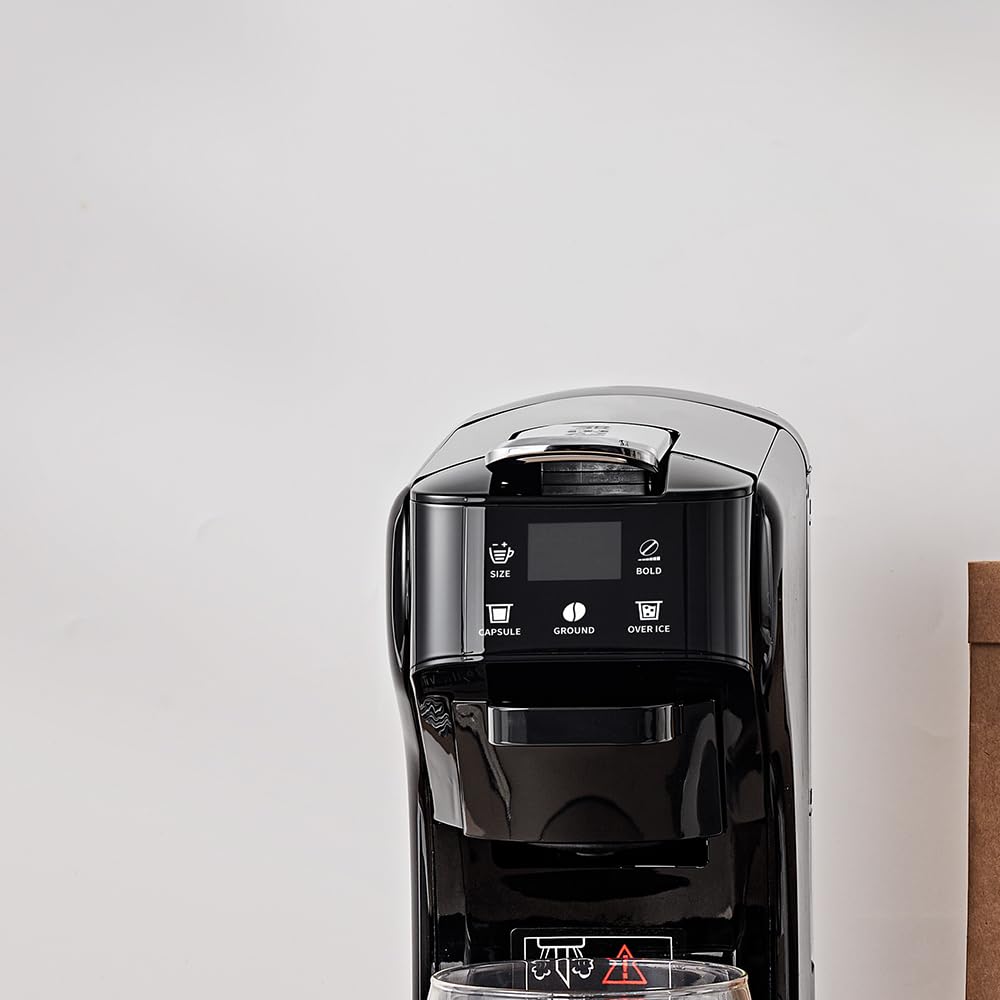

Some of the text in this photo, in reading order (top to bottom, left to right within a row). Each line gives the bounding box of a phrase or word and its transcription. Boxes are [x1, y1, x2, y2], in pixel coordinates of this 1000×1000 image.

[490, 570, 511, 578] SIZE
[636, 567, 662, 576] BOLD
[478, 628, 521, 636] CAPSULE
[553, 626, 595, 635] GROUND
[627, 625, 671, 634] OVER ICE
